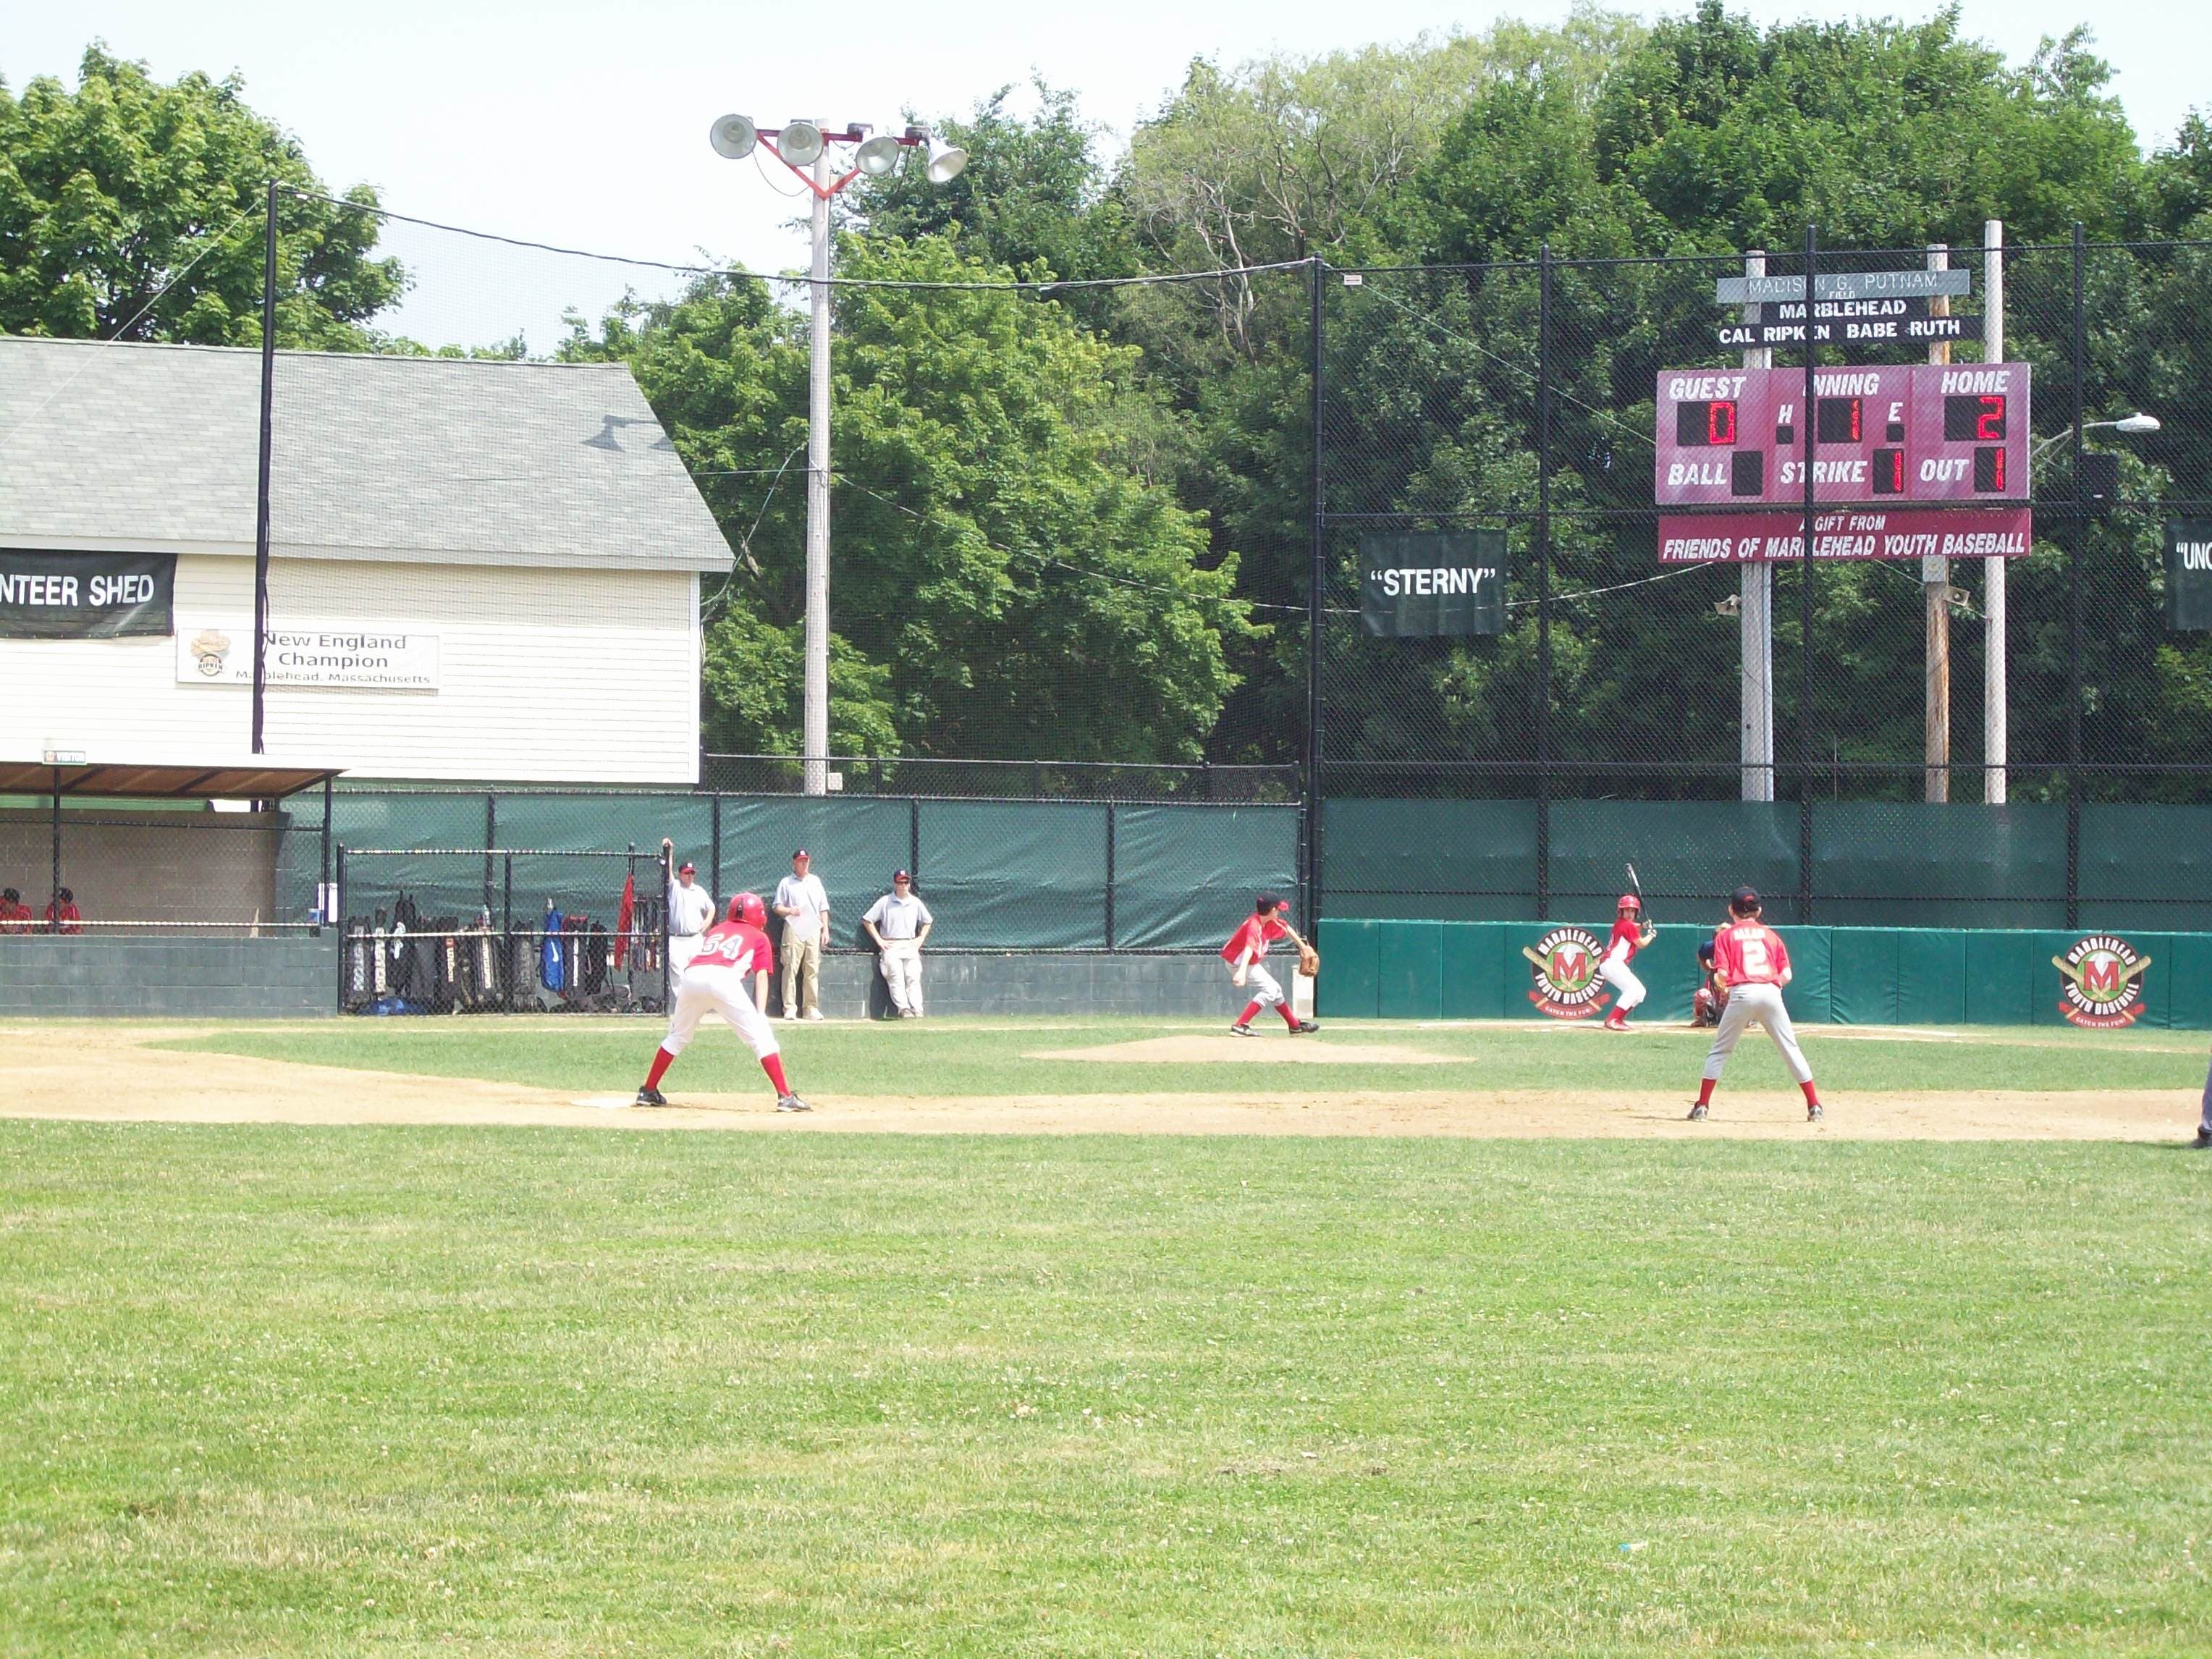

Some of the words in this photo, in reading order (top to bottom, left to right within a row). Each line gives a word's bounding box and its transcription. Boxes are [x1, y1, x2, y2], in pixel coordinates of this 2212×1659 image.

[1749, 276, 1825, 295] MADISN
[1865, 272, 1938, 290] PUTNAM
[1719, 326, 1755, 345] CAL
[1763, 324, 1830, 342] RIPKN
[1846, 322, 1898, 339] BABE
[1909, 319, 1960, 337] RUTH
[1668, 376, 1747, 400] GUEST
[1941, 371, 2011, 394] HOME
[1778, 404, 1794, 424] H
[1888, 402, 1904, 422] E
[1977, 396, 2005, 439] 2
[1667, 463, 1727, 486] BALL
[1920, 459, 1970, 482] OUT
[1815, 516, 1844, 532] GIFT
[1849, 515, 1886, 531] FROM
[1663, 537, 1732, 560] FRIENDS
[1738, 537, 1761, 558] OF
[1884, 534, 1938, 555] YOUTH
[1942, 532, 2025, 554] BASEBALL
[88, 574, 154, 607] SHED
[266, 632, 311, 646] New
[319, 633, 407, 651] England
[279, 651, 389, 670] Champion
[329, 672, 431, 684] Massachusetts
[1537, 929, 1604, 957] MARBLEHEAD
[2067, 937, 2137, 966] MARBLEHEAD
[1552, 952, 1587, 982] M
[1742, 940, 1770, 976] 2
[2082, 961, 2120, 991] M
[2065, 982, 2094, 1013] YOUTH
[2095, 983, 2140, 1016] BASEBALL
[2076, 1016, 2096, 1027] CATCH
